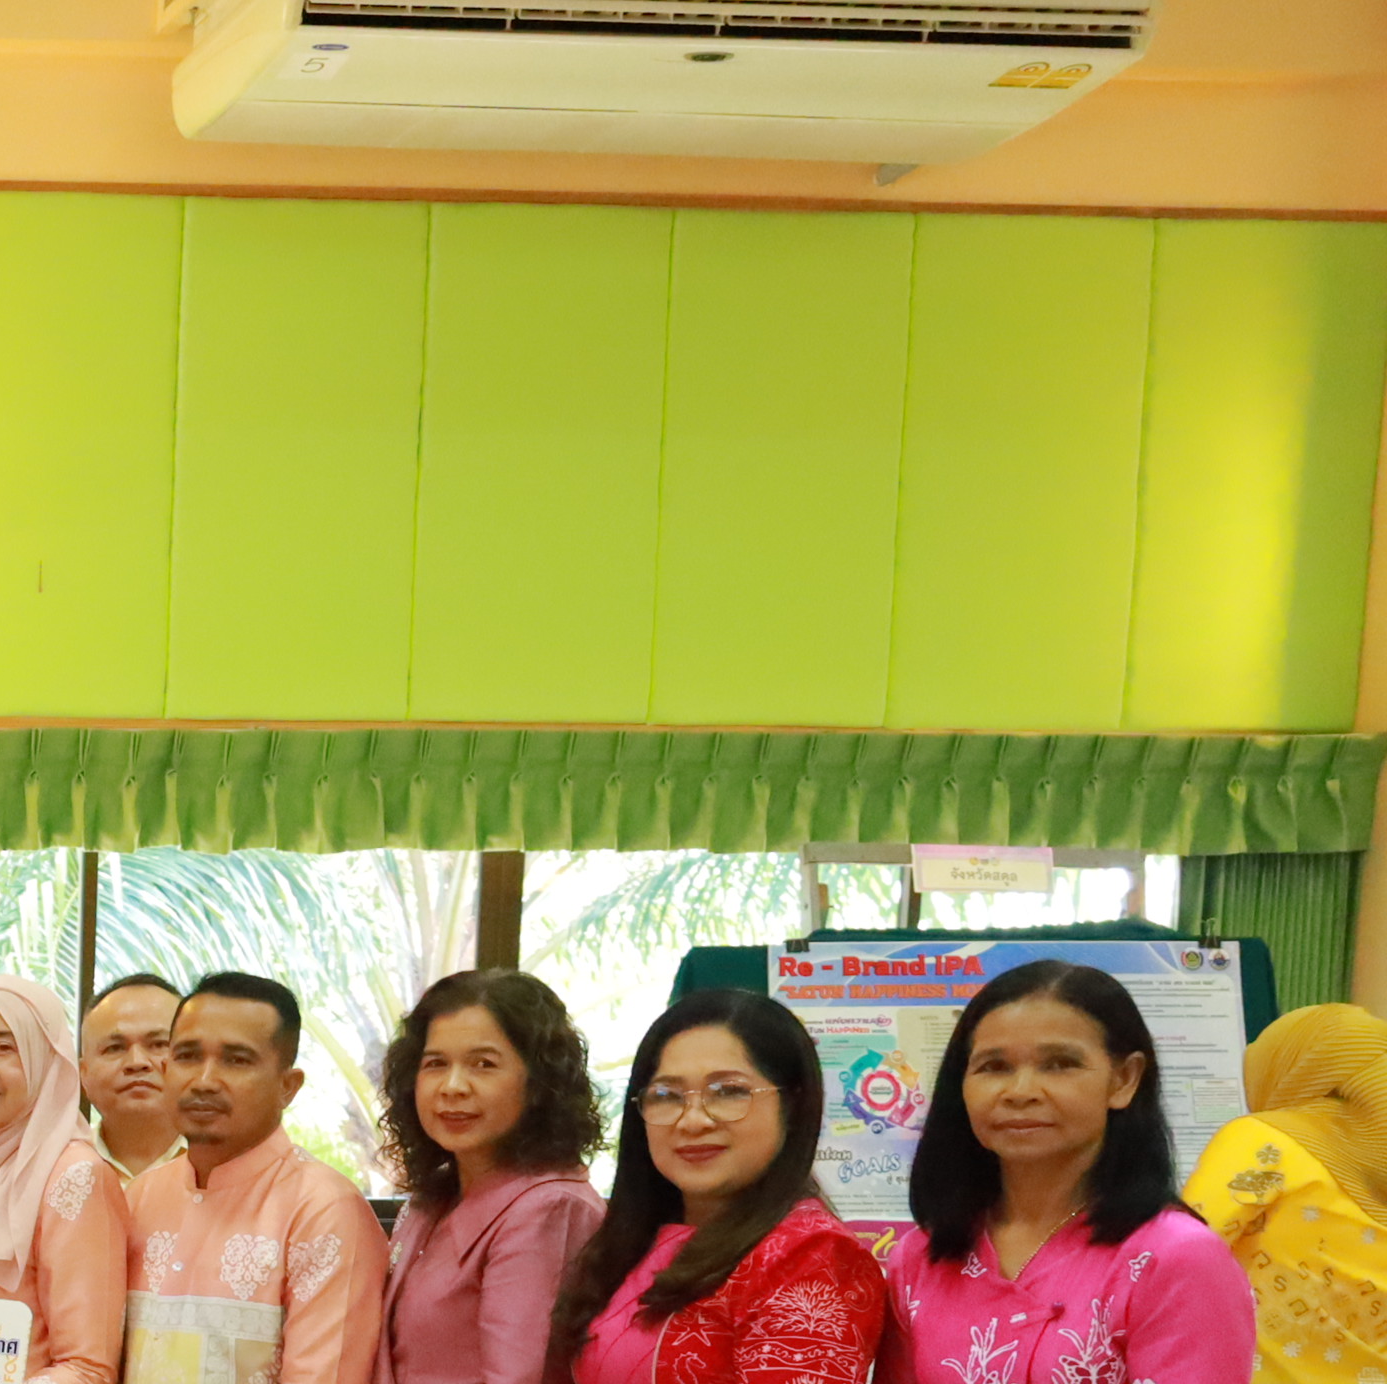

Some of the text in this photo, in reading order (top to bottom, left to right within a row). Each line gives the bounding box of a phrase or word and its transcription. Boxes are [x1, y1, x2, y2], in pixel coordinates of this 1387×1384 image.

[778, 956, 814, 977] Re
[842, 954, 926, 977] Brand
[935, 955, 985, 976] IPA
